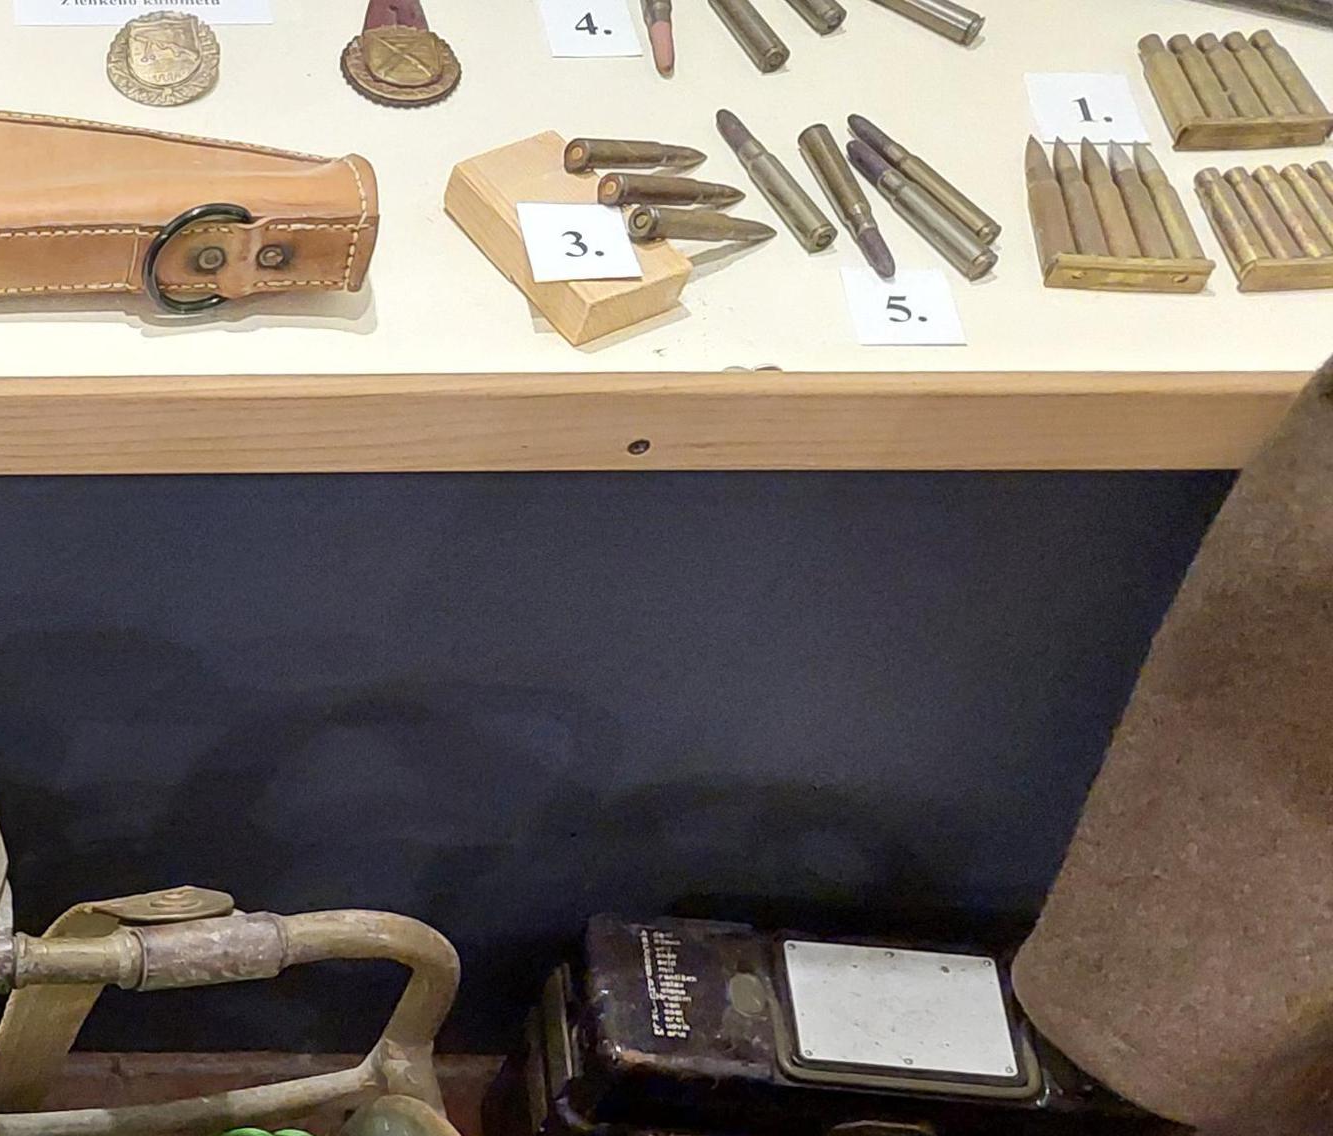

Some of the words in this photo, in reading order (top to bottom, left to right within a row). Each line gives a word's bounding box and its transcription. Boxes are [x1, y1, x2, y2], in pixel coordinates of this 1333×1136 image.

[574, 11, 613, 36] 4.
[1074, 97, 1113, 123] 1.
[561, 230, 605, 258] 3.
[884, 295, 929, 323] 5.
